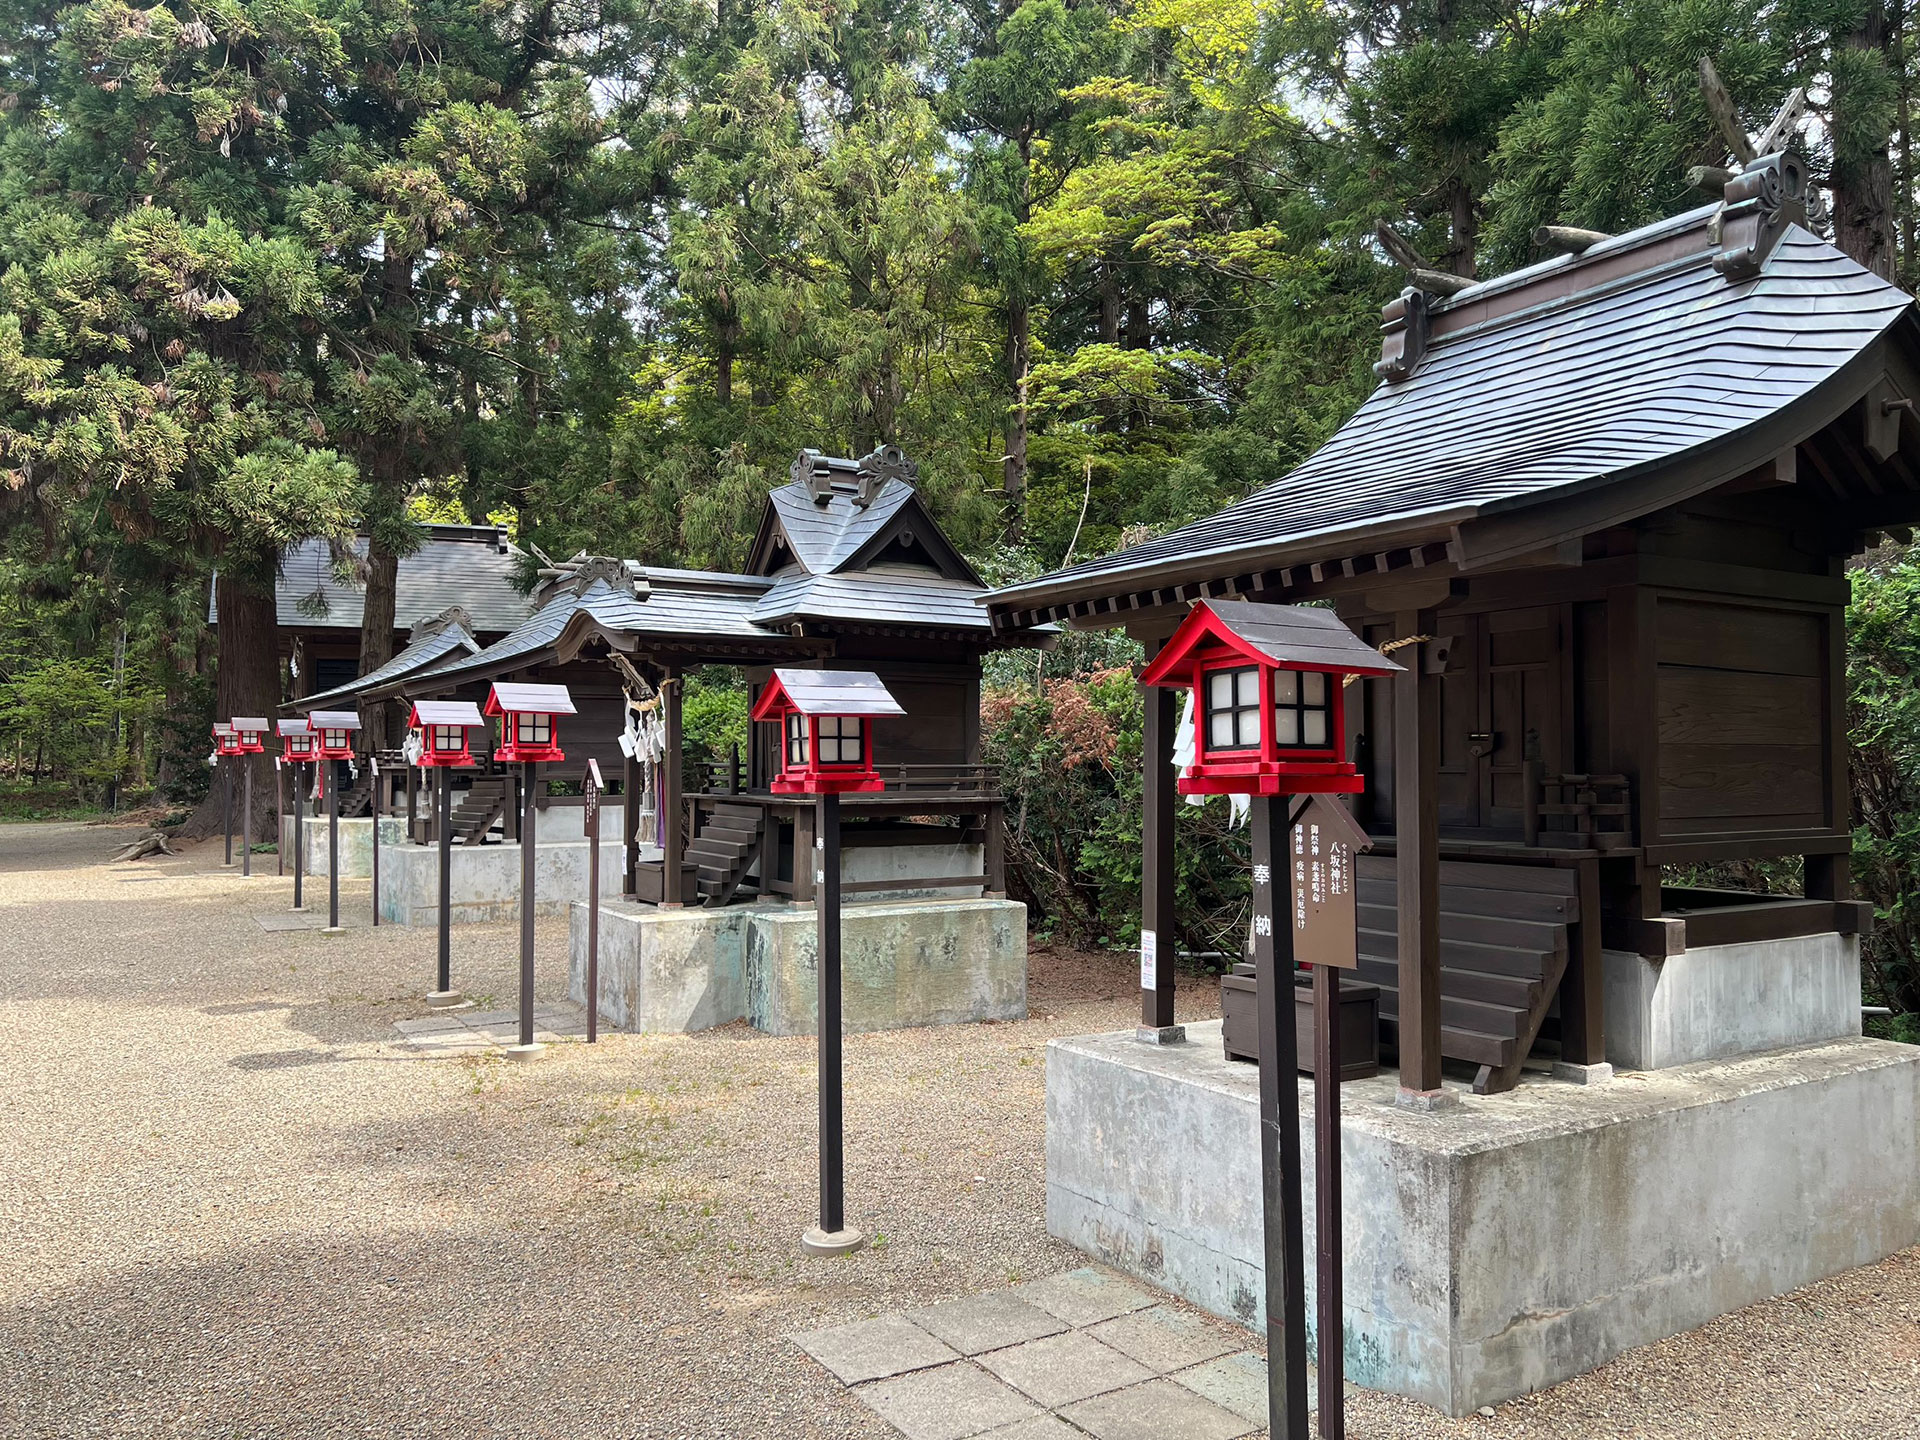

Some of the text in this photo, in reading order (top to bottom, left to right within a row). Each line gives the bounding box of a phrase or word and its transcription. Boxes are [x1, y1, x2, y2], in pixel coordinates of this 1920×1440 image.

[1329, 841, 1341, 895] 八坂神社
[1253, 864, 1272, 937] 奉納
